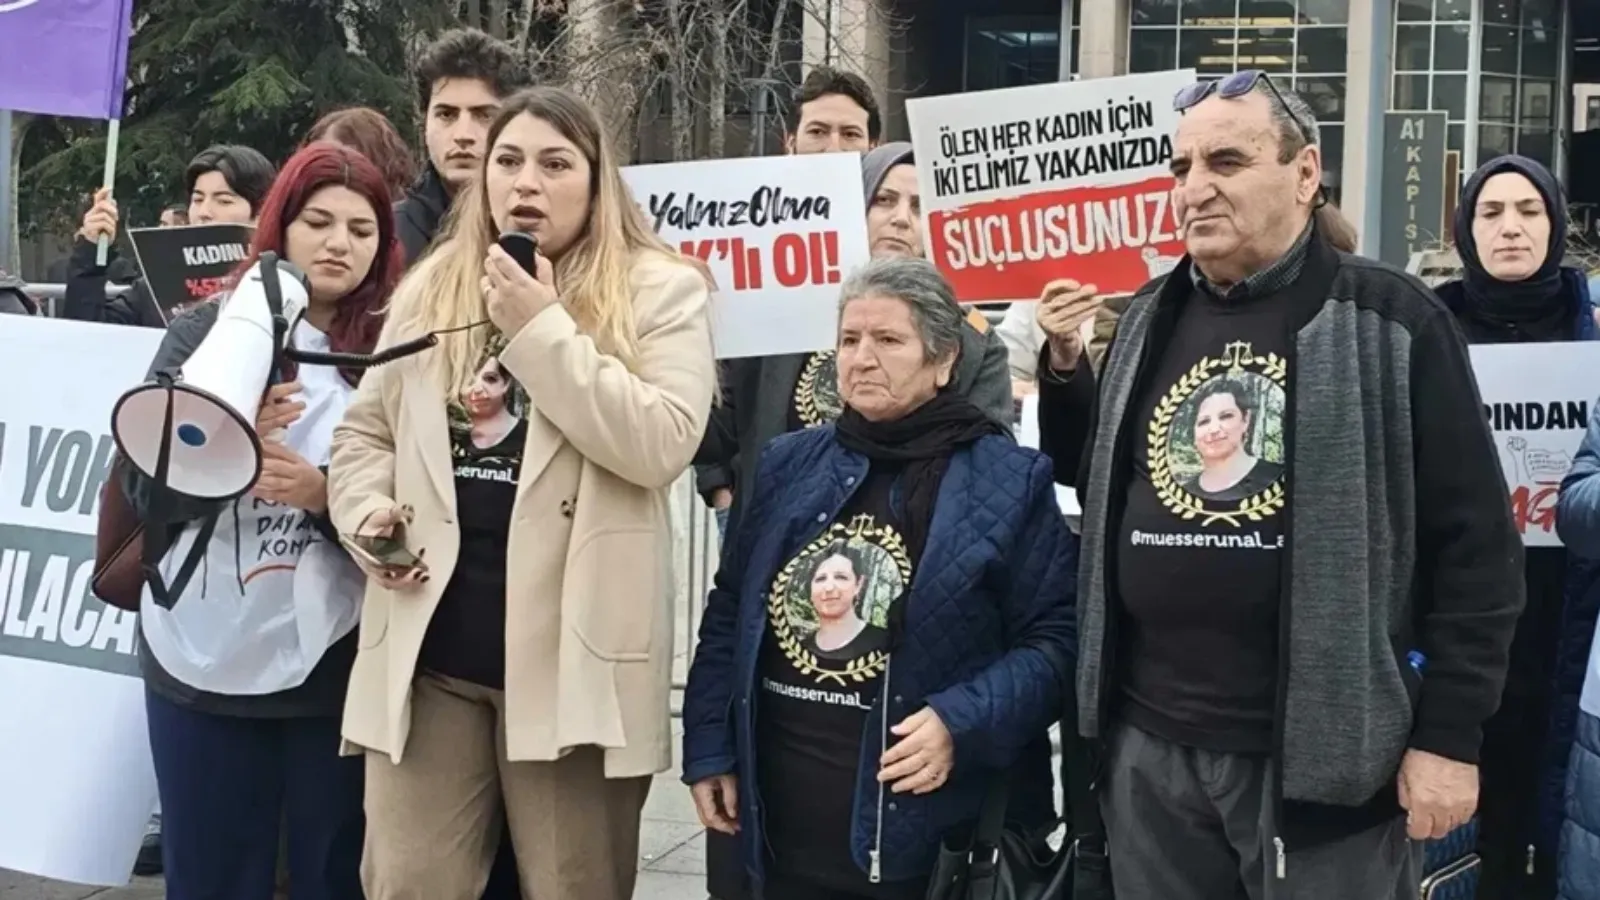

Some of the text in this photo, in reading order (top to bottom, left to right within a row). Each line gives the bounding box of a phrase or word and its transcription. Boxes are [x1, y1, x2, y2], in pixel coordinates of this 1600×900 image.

[940, 96, 1153, 159] ÖLEN HER KADIN İÇİN
[1400, 118, 1425, 140] A1
[932, 134, 1174, 197] İKİ ELİMİZ YAKANIZDA
[182, 242, 252, 267] KADINL
